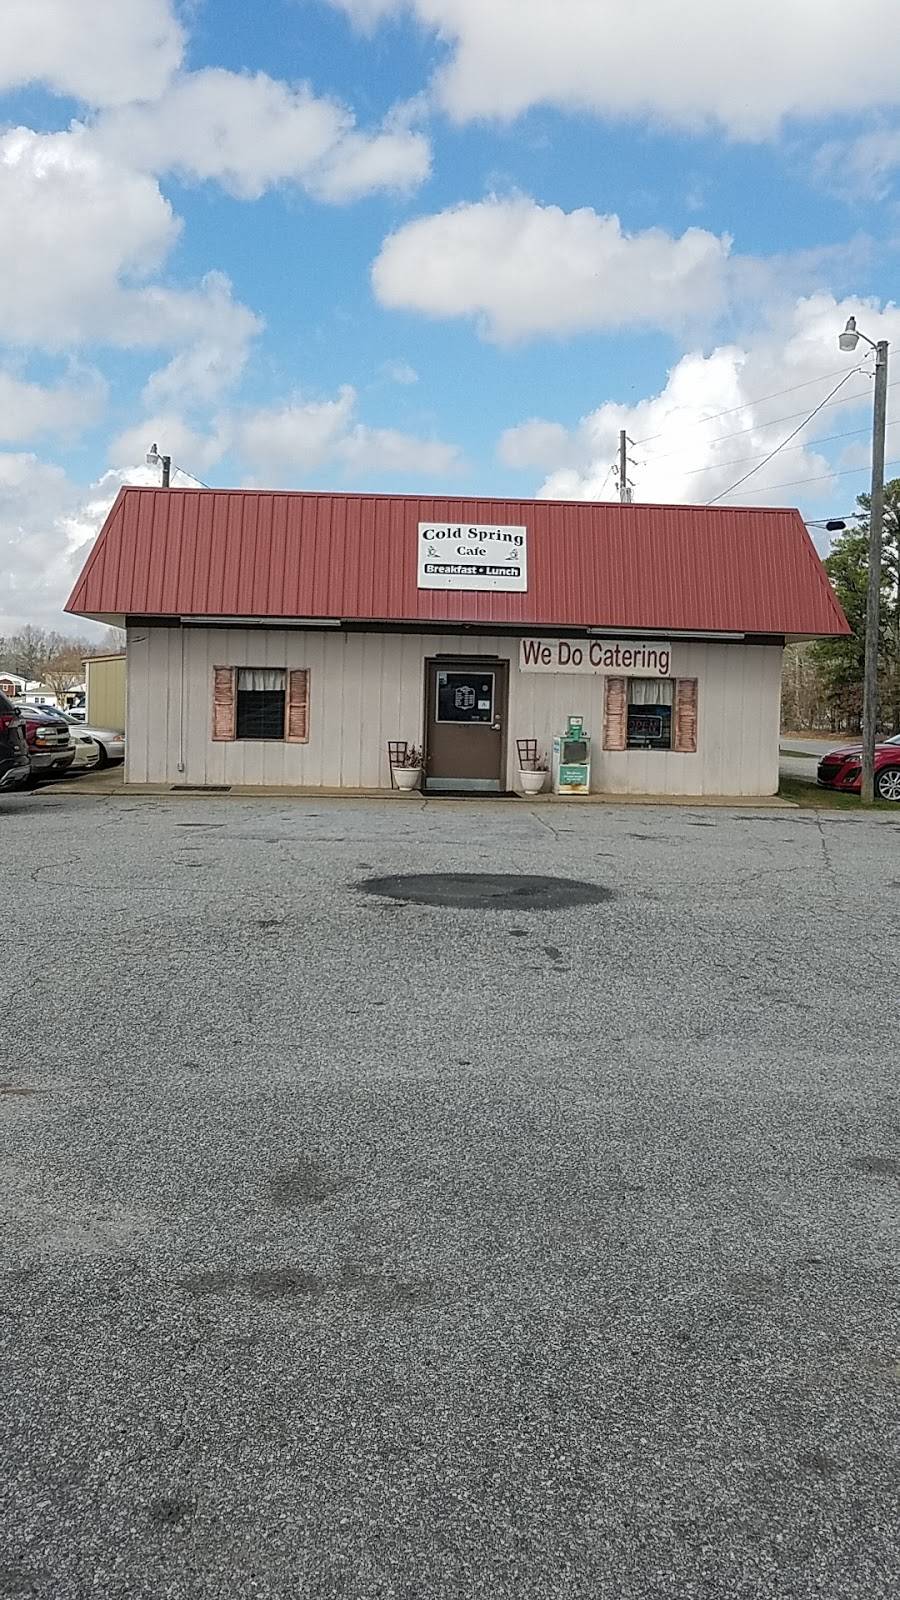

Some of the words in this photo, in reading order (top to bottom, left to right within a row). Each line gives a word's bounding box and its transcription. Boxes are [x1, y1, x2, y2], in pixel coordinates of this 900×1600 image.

[423, 528, 461, 540] Cold
[467, 528, 524, 546] Spring
[456, 546, 487, 556] Cafe
[426, 564, 477, 574] Breakfast
[486, 566, 519, 576] Lunch
[522, 640, 551, 665] We
[558, 640, 583, 666] Do
[589, 642, 669, 675] Catering
